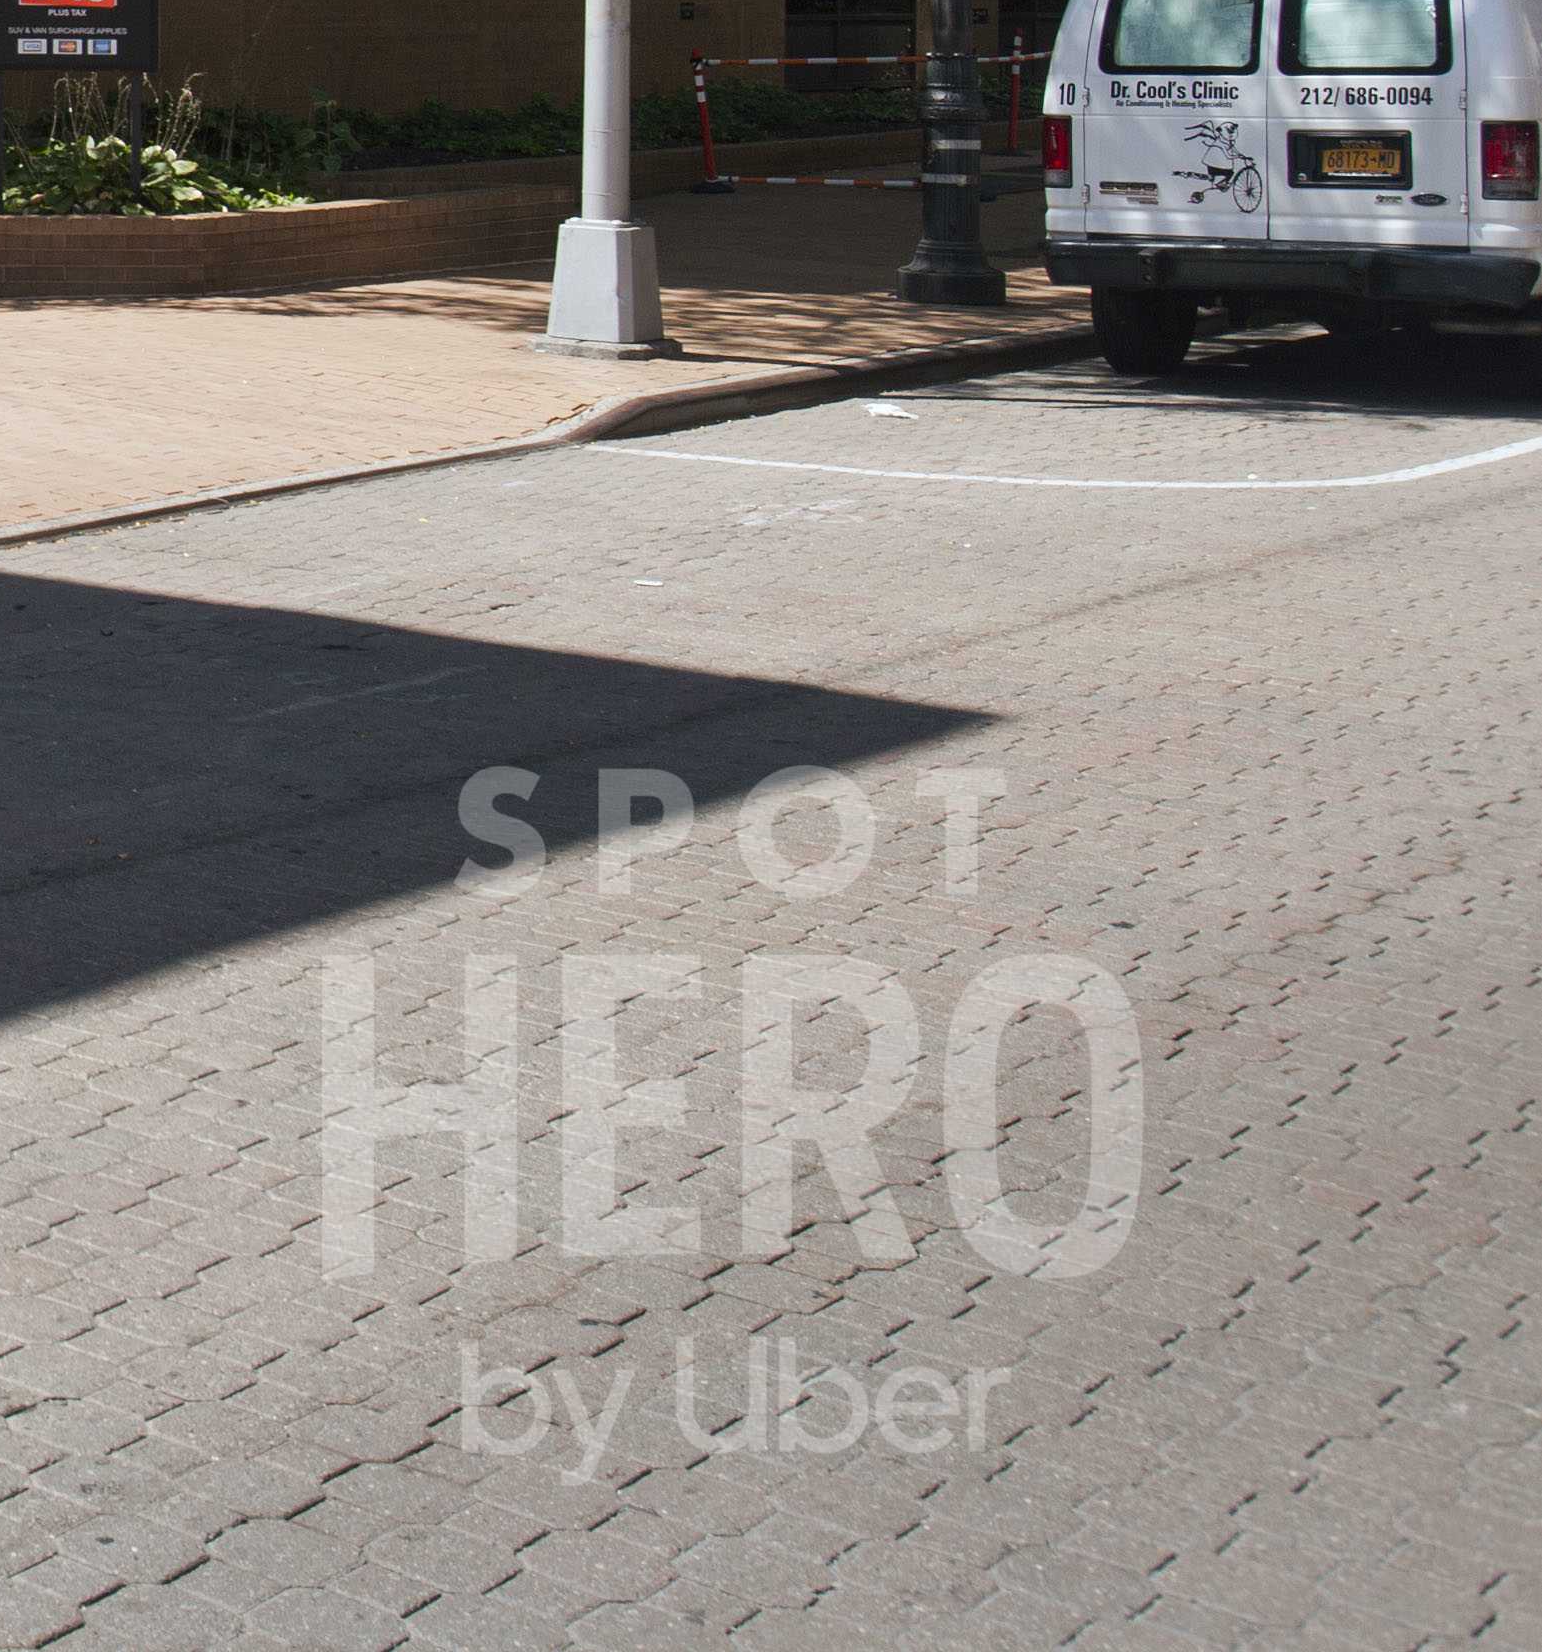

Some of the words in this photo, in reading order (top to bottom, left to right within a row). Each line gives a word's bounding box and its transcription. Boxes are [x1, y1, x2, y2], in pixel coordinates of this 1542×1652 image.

[48, 9, 70, 17] PLUS
[71, 9, 88, 17] TAX
[1059, 83, 1076, 106] 10
[1110, 80, 1131, 99] Dr.
[1137, 80, 1187, 99] Cool's
[1192, 80, 1239, 100] Clinic
[1300, 86, 1340, 108] 212/
[1345, 86, 1434, 106] 686-0094
